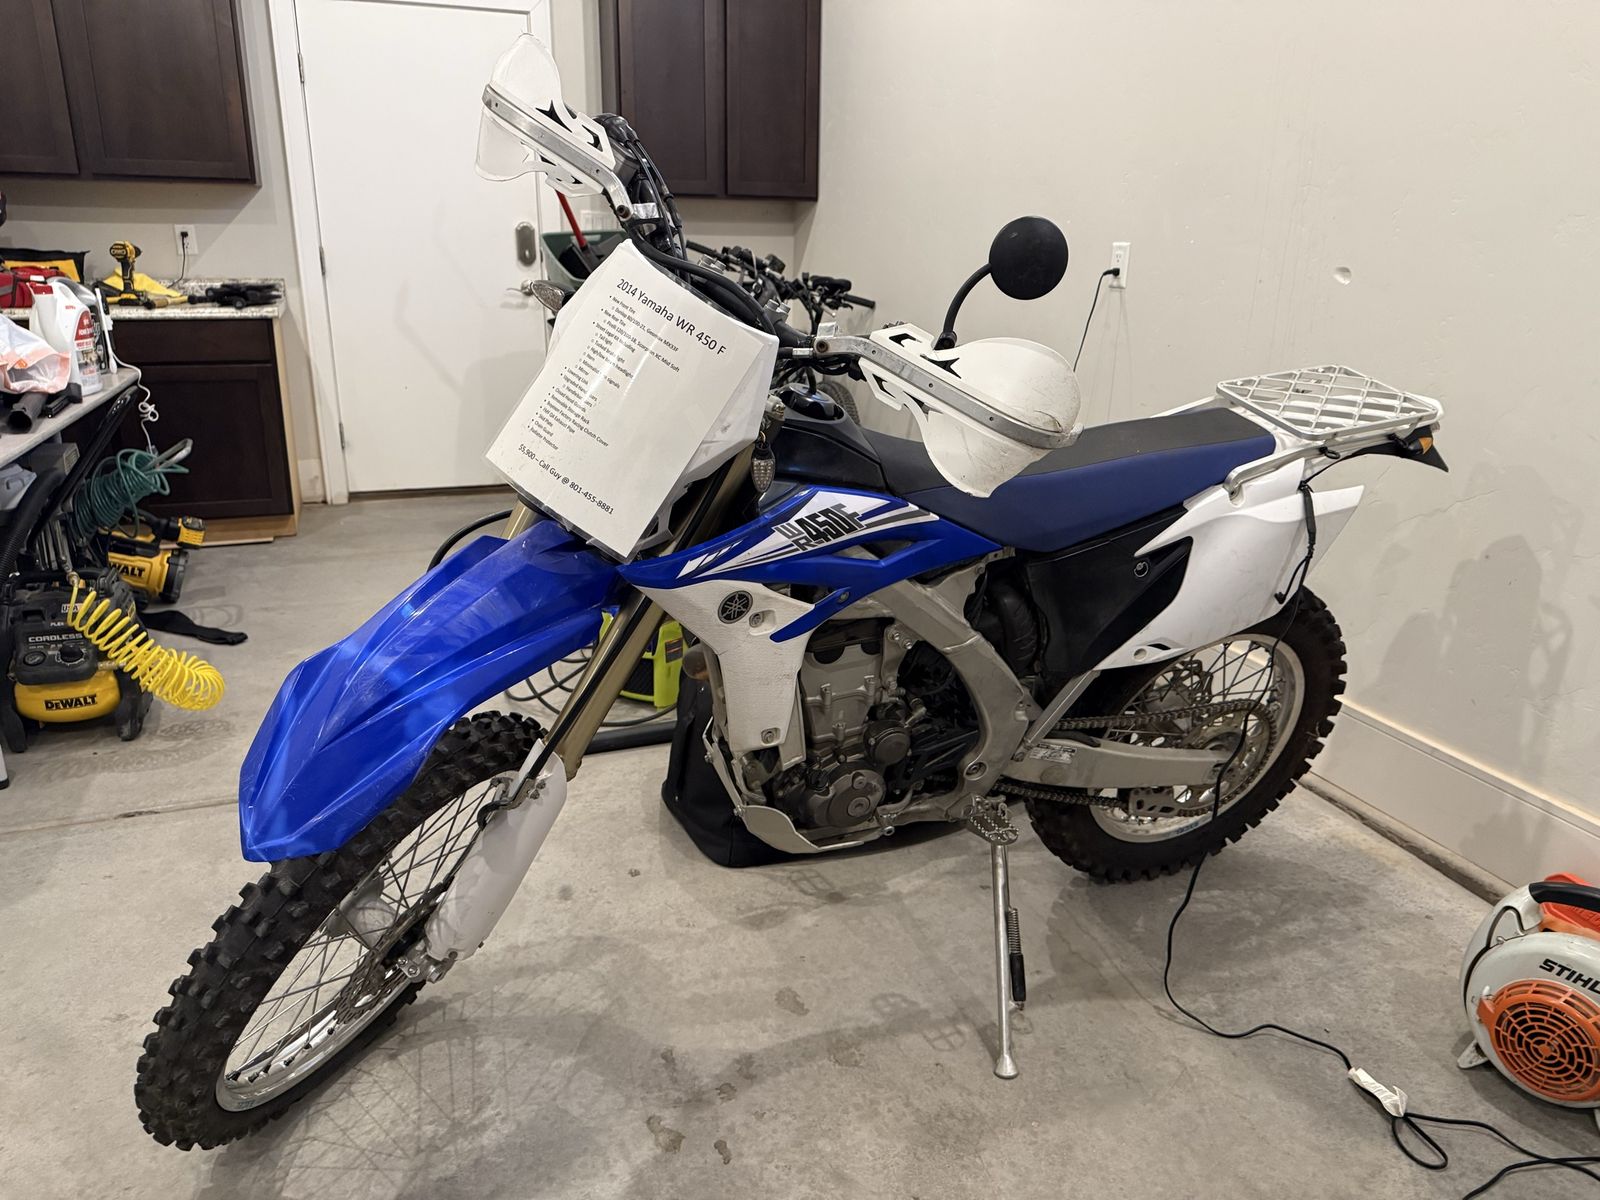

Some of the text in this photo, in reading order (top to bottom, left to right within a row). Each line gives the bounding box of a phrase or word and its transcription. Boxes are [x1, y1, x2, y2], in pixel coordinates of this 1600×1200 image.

[616, 277, 726, 356] 2014 Yamaha WR 450 F
[654, 352, 662, 360] XC
[660, 357, 671, 366] Mid
[670, 363, 680, 372] Soft
[578, 365, 590, 376] Mirror
[606, 377, 620, 389] signals
[516, 442, 536, 461] $5,900
[538, 458, 551, 472] Call
[548, 466, 563, 480] Guy
[560, 476, 570, 485] @
[568, 480, 615, 516] 801-455-8881
[109, 562, 146, 577] WALT
[28, 633, 83, 643] CORDLESS
